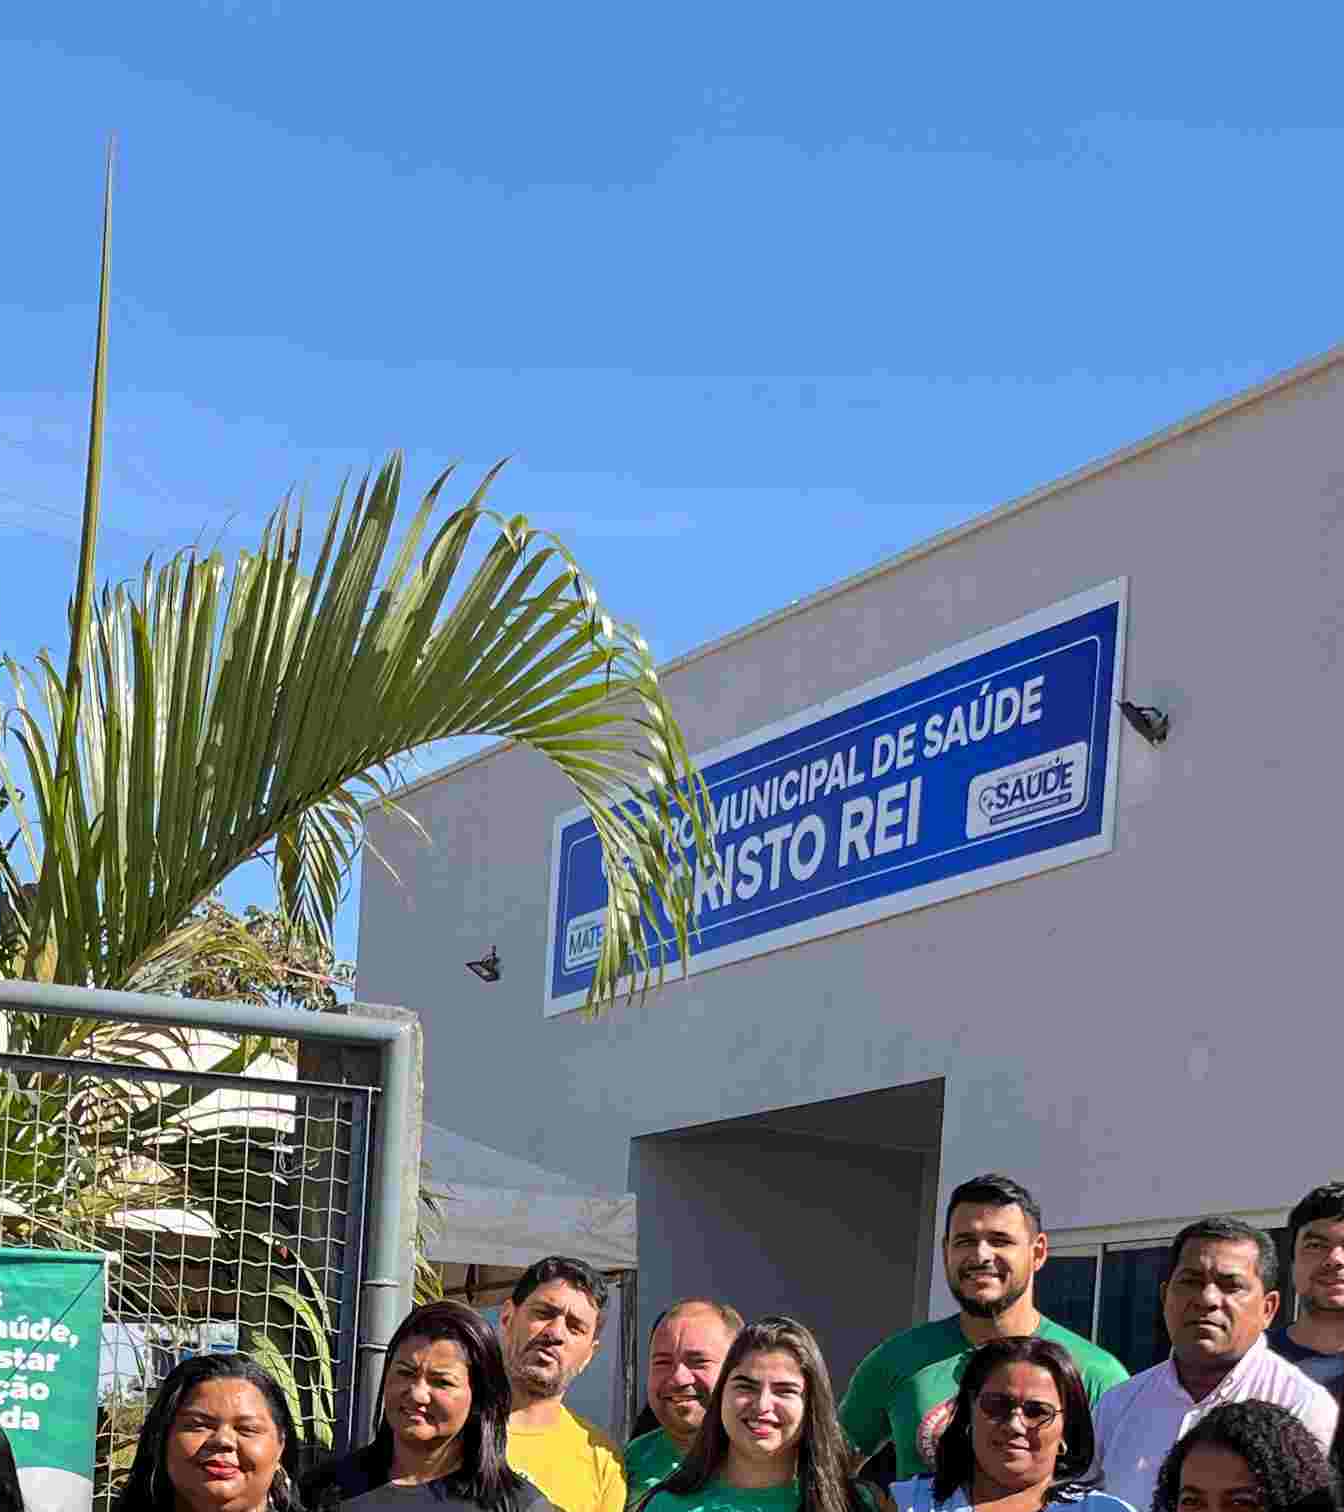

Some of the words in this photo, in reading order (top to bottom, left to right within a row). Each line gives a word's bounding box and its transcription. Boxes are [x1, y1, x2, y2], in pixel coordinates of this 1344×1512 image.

[711, 745, 865, 836] MUNICIPAL
[871, 723, 917, 778] DE
[922, 675, 1045, 759] SAÚDE
[838, 776, 923, 870] REI
